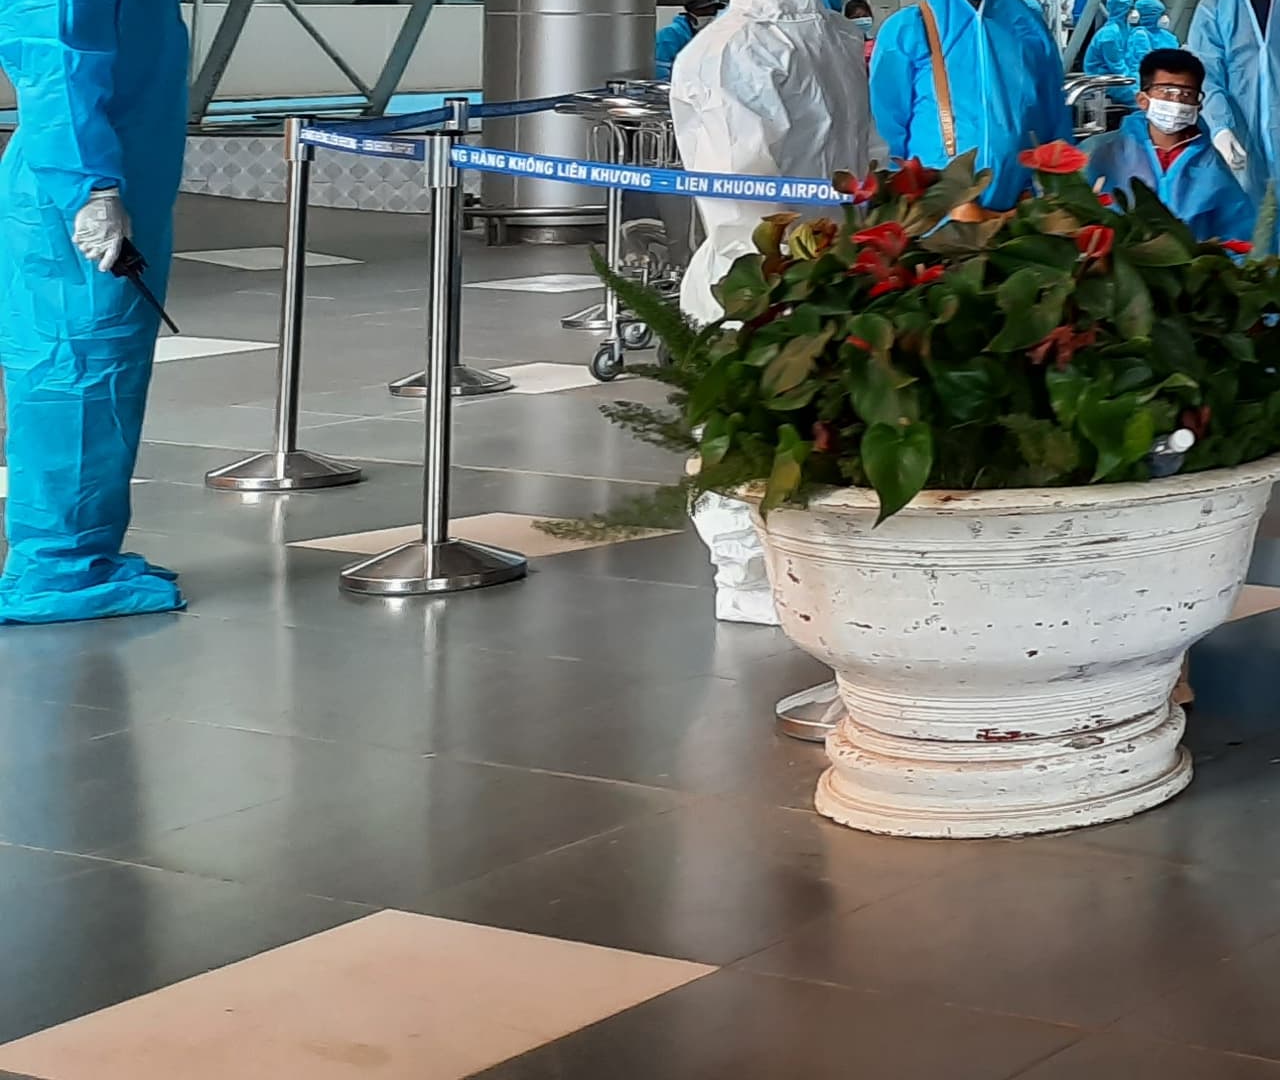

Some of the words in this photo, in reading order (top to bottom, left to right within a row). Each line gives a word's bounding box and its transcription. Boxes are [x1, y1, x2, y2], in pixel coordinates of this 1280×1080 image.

[470, 150, 505, 167] HÀNG
[509, 156, 553, 174] KHÔNG
[557, 161, 587, 179] LIÊN
[591, 167, 651, 187] KHƯƠNG
[676, 176, 708, 192] LIEN
[713, 179, 776, 197] KHUONG
